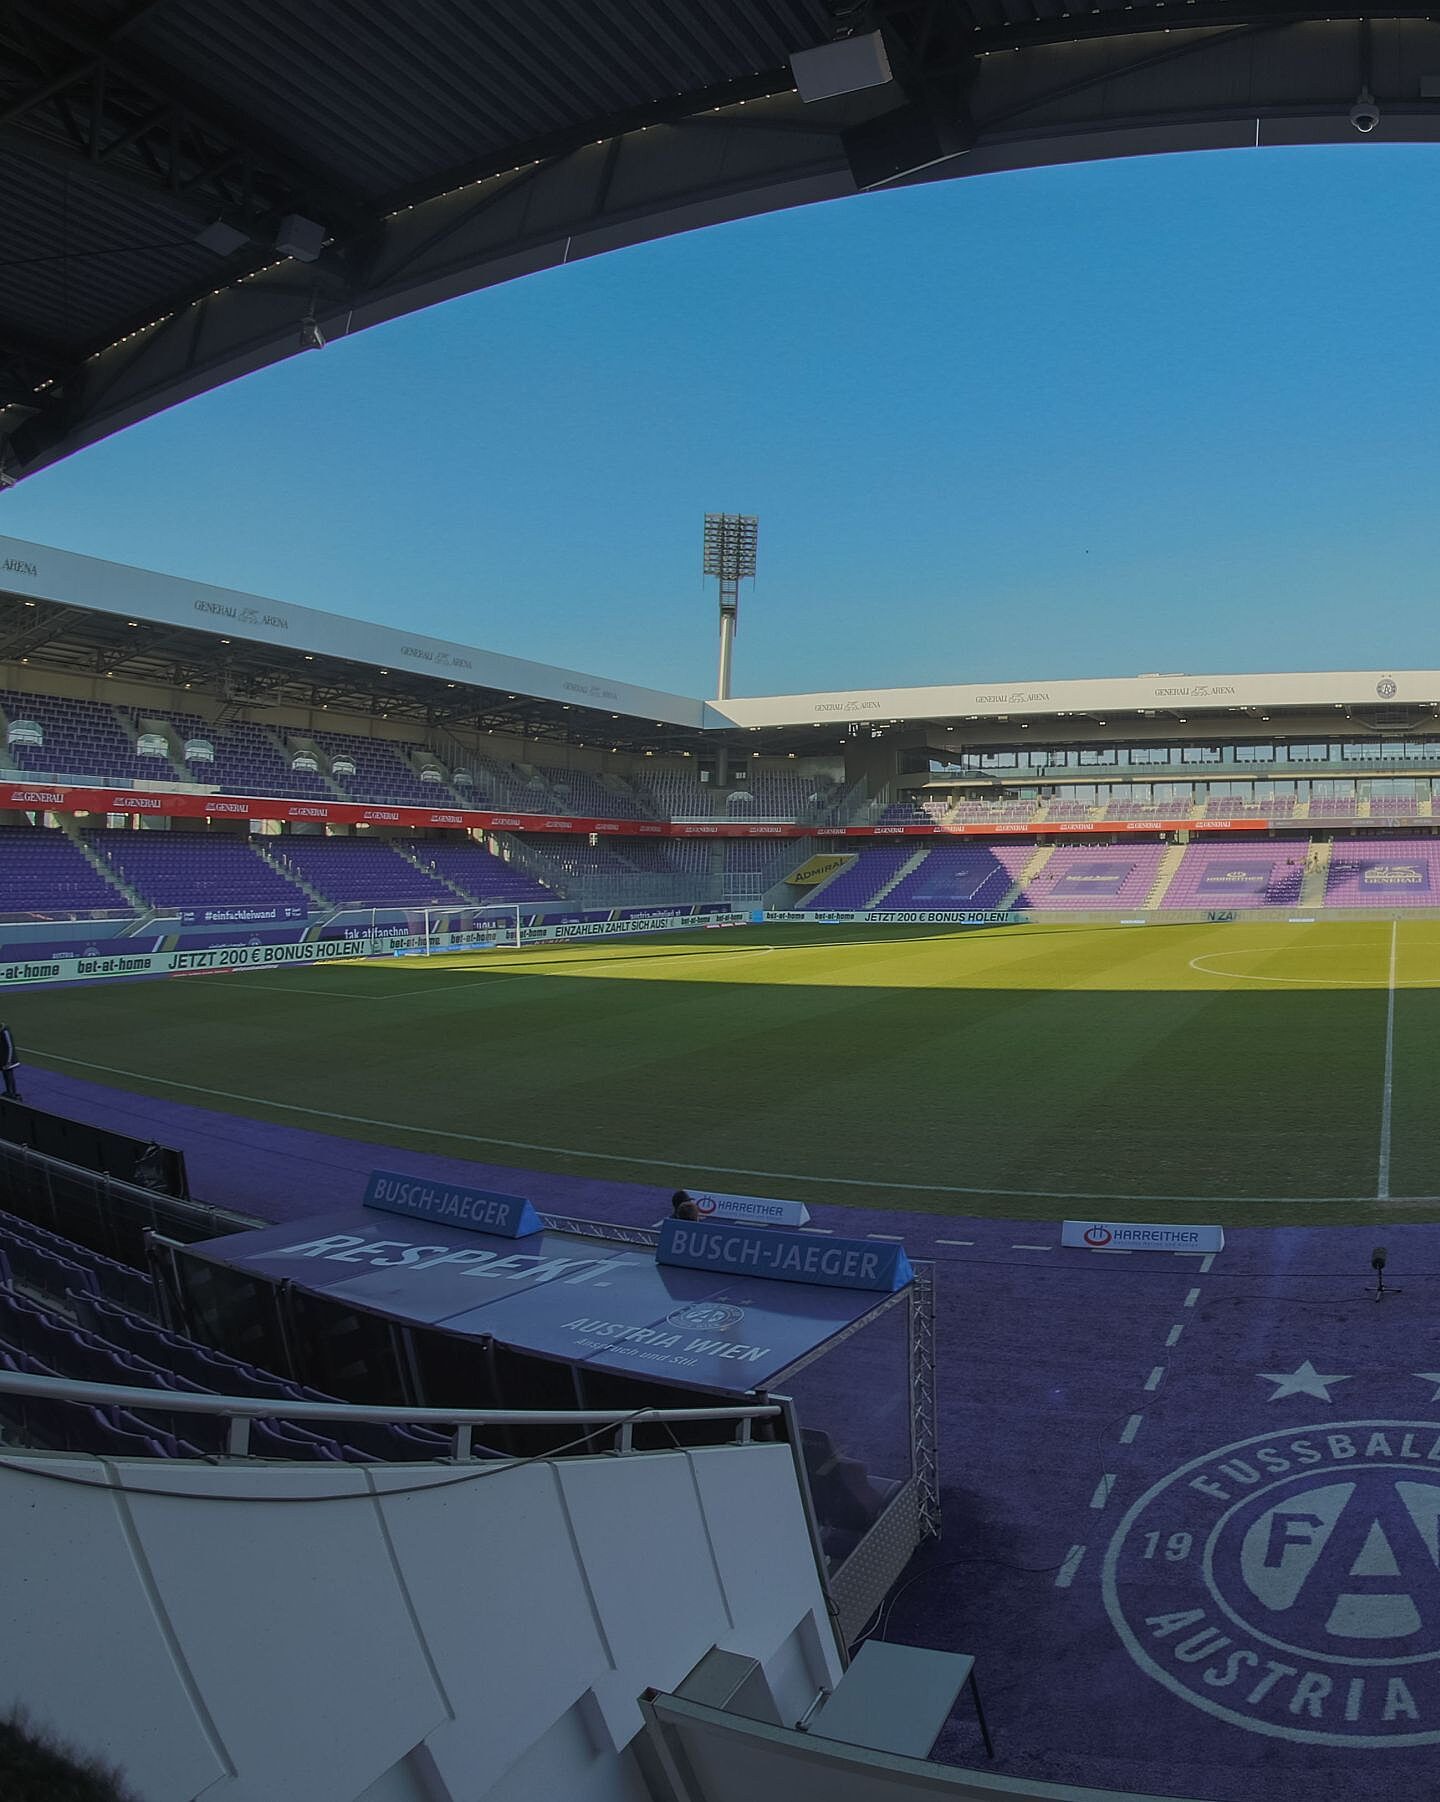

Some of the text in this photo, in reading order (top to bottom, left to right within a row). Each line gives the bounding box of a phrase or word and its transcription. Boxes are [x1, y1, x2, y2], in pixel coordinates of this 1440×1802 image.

[1, 558, 37, 576] ARENA
[194, 600, 288, 629] GENERALI ARENA
[401, 646, 433, 660] GENERALI
[975, 693, 1049, 703] GENERALI ARENA
[1155, 686, 1235, 697] GENERALI ARENA
[814, 701, 880, 712] GENERALI ARENA
[24, 791, 64, 803] GENERALI
[124, 798, 161, 808] GENERALI
[215, 803, 249, 812] GENERALI
[298, 808, 328, 817] GENERALI
[372, 812, 399, 820] GENERALI
[437, 815, 463, 823] GENERALI
[795, 857, 847, 882] ADMIRAL
[205, 909, 276, 920] #einfachleiwand
[681, 916, 710, 925] bet-at-home
[815, 912, 854, 920] bet-at-home
[865, 913, 1008, 921] JETZT 200 € BONUS HOLEN!
[555, 919, 668, 937] EINZAHLEN ZAHLT SICH AUS!
[451, 933, 496, 944] bet-at-home
[168, 942, 364, 969] JETZT 200 € BONUS HOLEN!
[78, 957, 151, 973] bet-at-home
[373, 1179, 510, 1227] BUSCH-JAEGER
[717, 1199, 784, 1217] HARREITHER
[1113, 1229, 1199, 1243] HARREITHER
[279, 1234, 640, 1288] RESPEKT.
[670, 1230, 879, 1281] BUSCH-JAEGER
[560, 1317, 772, 1362] AUSTRIA WIEN
[640, 1350, 672, 1362] und
[1142, 1531, 1193, 1561] 19
[1145, 1607, 1419, 1722] AUSTRIA
